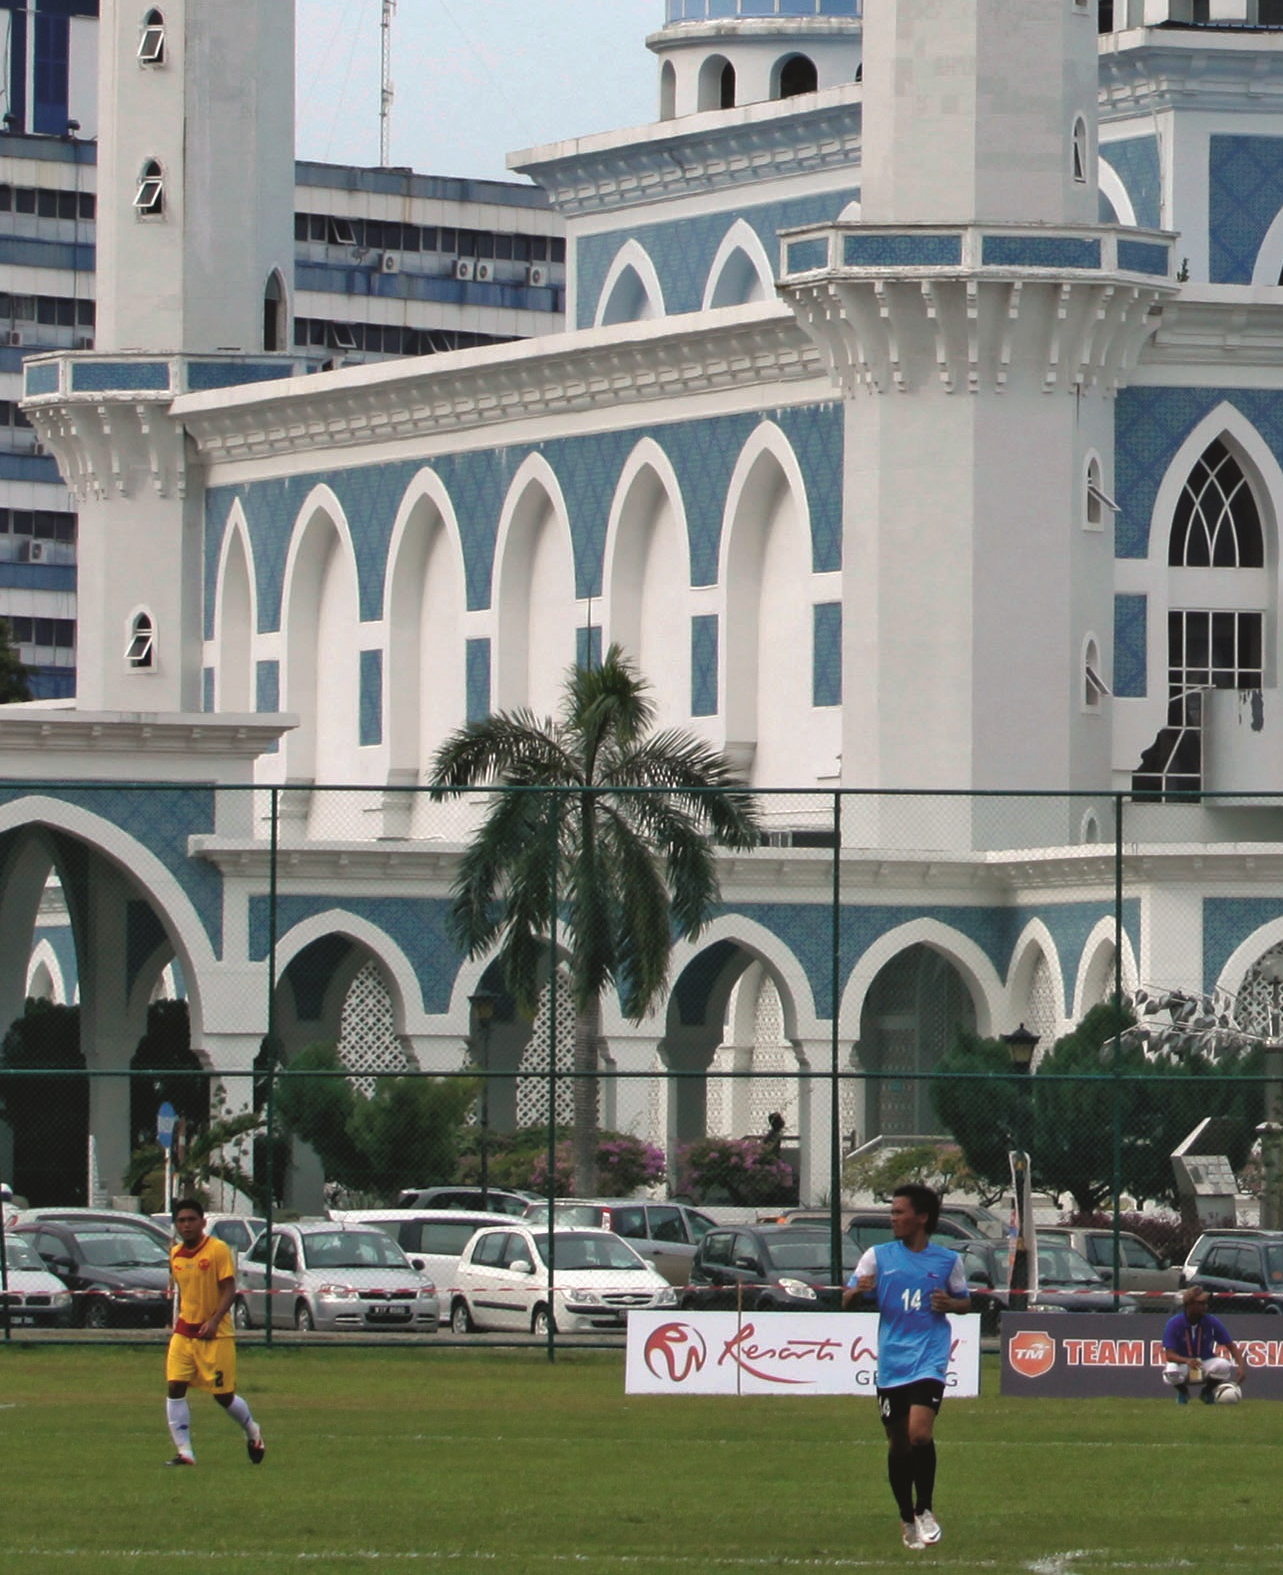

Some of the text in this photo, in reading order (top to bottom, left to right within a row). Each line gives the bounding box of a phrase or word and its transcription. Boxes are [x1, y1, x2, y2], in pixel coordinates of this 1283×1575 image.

[901, 1288, 922, 1311] 14
[718, 1323, 842, 1383] Resorts
[1015, 1347, 1045, 1360] TM
[1063, 1339, 1145, 1366] TEAM
[215, 1370, 224, 1387] 2
